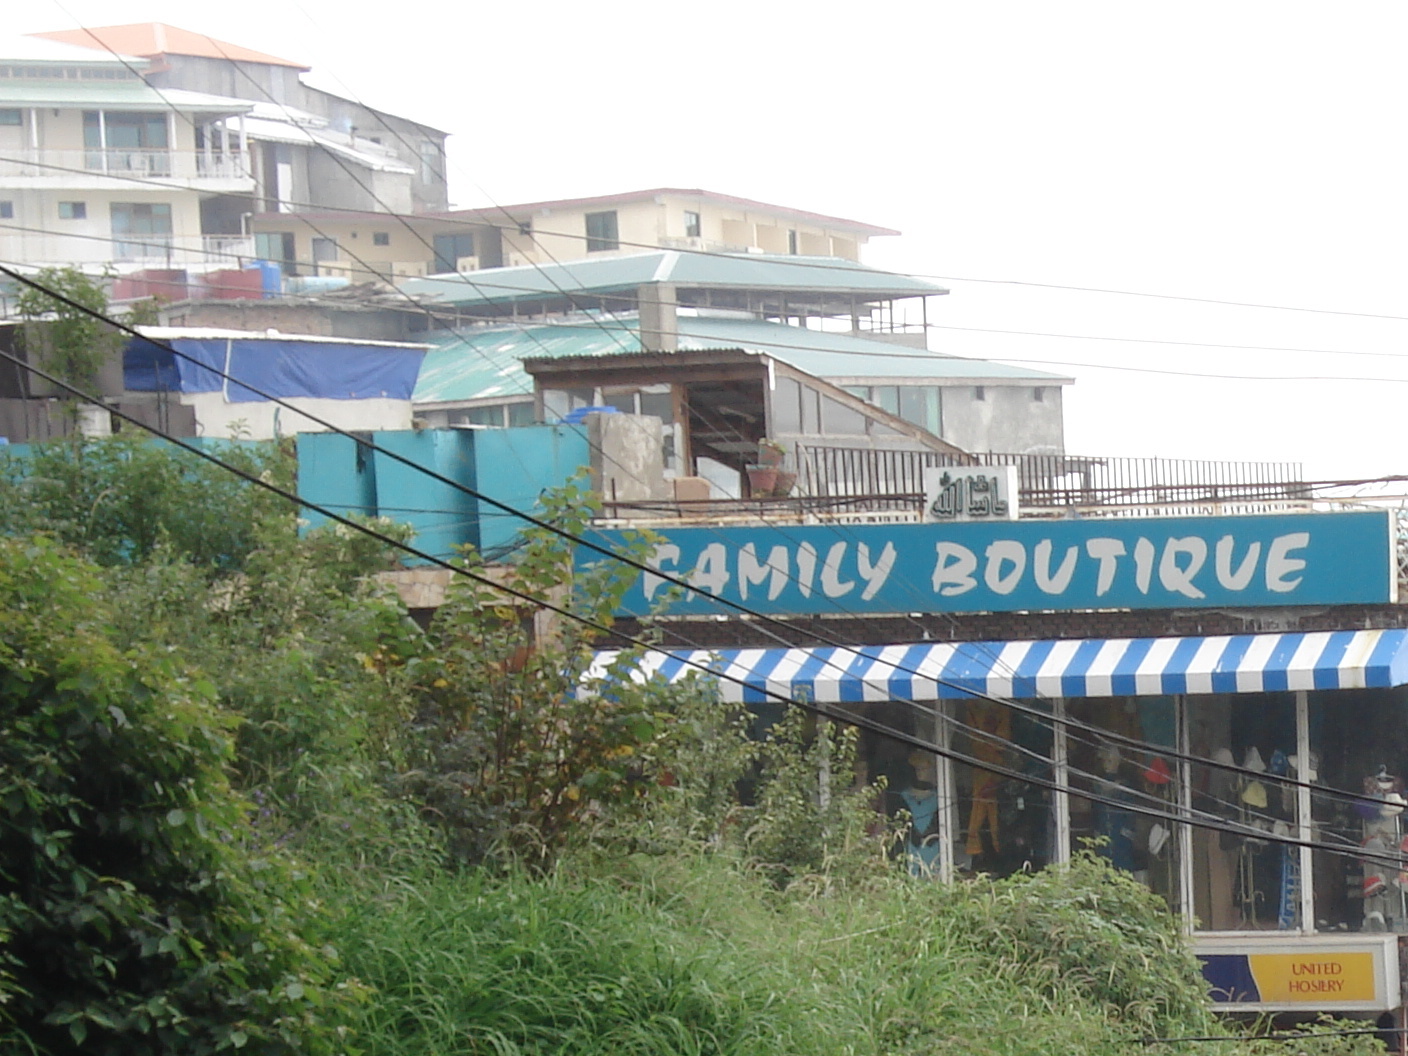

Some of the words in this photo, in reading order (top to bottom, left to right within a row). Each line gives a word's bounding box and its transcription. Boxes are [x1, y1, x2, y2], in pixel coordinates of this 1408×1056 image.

[642, 540, 898, 602] FAMILY
[931, 532, 1311, 599] BOUTIQUE
[1291, 962, 1342, 976] UNITED
[1288, 979, 1345, 993] HOSIERY
